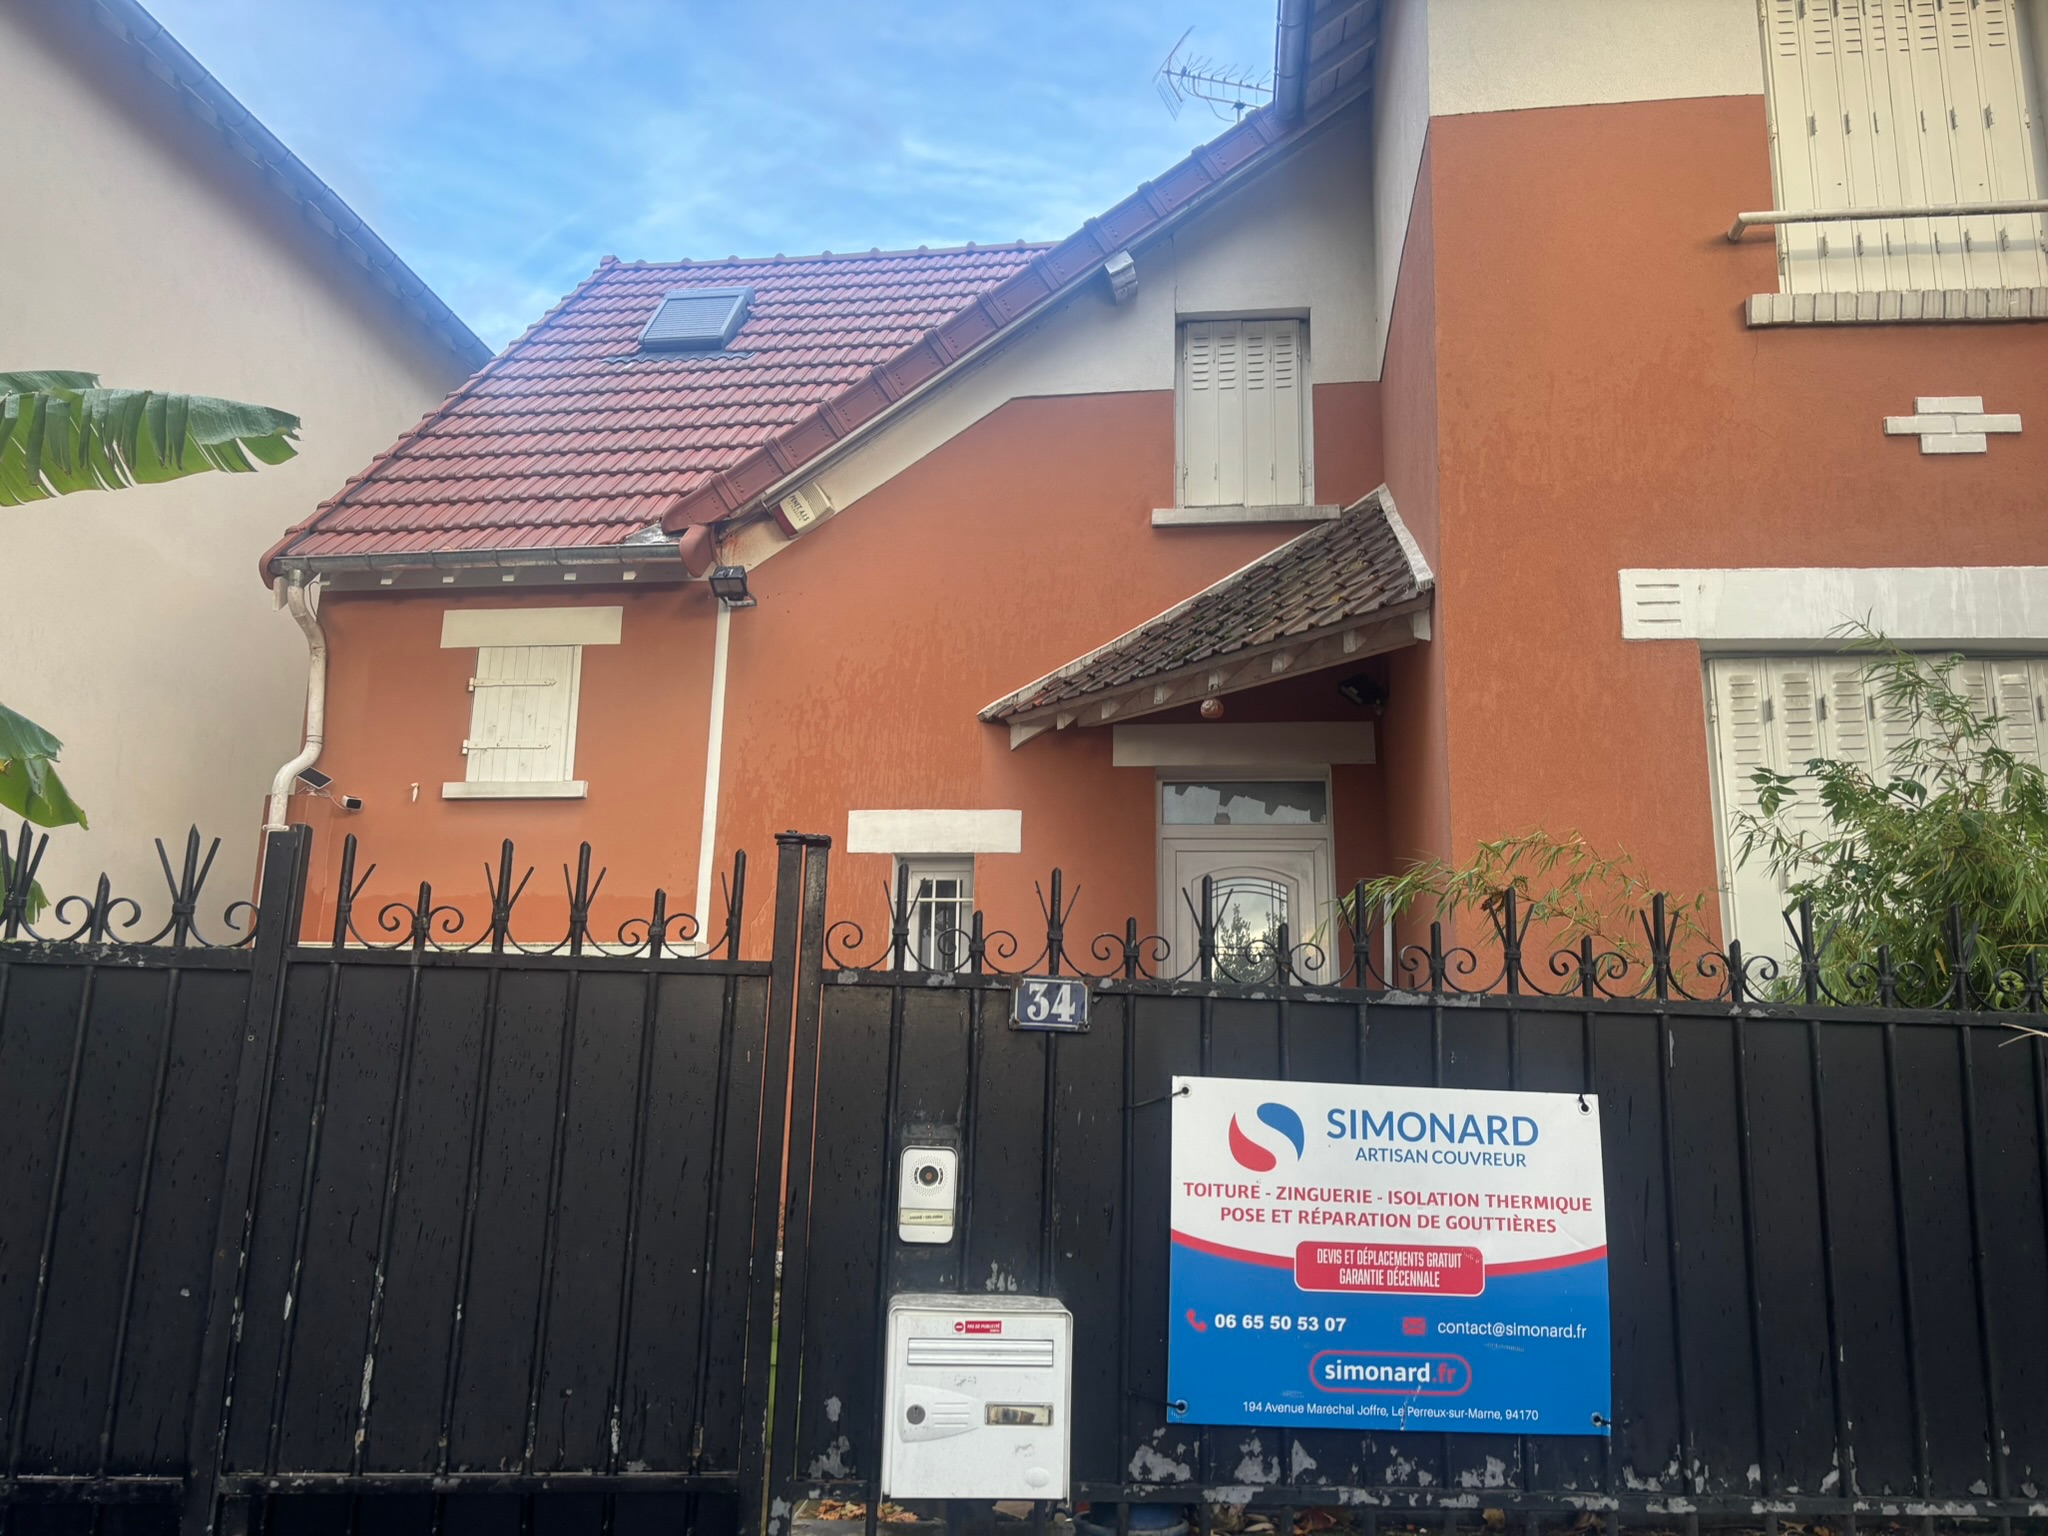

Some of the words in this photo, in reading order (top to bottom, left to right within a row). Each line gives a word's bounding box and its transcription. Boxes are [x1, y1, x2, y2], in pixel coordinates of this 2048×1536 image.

[1027, 983, 1076, 1022] 34
[1326, 1108, 1539, 1147] SIMONARD
[1355, 1147, 1428, 1164] ARTISAN
[1432, 1150, 1527, 1168] COUVREUR
[1183, 1182, 1261, 1200] TOITURE
[1276, 1186, 1373, 1204] ZINGUERIE
[1388, 1190, 1480, 1208] ISOLATION
[1485, 1194, 1593, 1214] THERMIQUE
[1220, 1207, 1266, 1223] POSE
[1271, 1209, 1292, 1224] ET
[1298, 1207, 1412, 1229] RÉPARATION
[1417, 1214, 1441, 1229] DE
[1445, 1214, 1557, 1234] GOUTTIÈRES
[1317, 1248, 1342, 1264] DEVIS
[1344, 1249, 1354, 1265] ET
[1357, 1246, 1425, 1268] DÉPLACEMENTS
[1426, 1251, 1462, 1269] GRATUIT
[1339, 1268, 1384, 1286] GARANTIE
[1387, 1266, 1440, 1288] DÉCENNALE
[1214, 1313, 1237, 1329] 06
[1242, 1315, 1264, 1330] 65
[1270, 1316, 1292, 1331] 50
[1297, 1317, 1319, 1332] 53
[1324, 1317, 1347, 1333] 07
[1437, 1321, 1588, 1339] contact@simonard.fr
[1324, 1359, 1457, 1384] simonard.fr
[1243, 1401, 1262, 1413] 194
[1264, 1403, 1305, 1414] Avenue
[1306, 1403, 1355, 1416] Maréchal
[1357, 1404, 1389, 1418] Joffre,
[1391, 1406, 1403, 1417] Le
[1407, 1406, 1503, 1421] Perreux-sur-Marne,
[1505, 1409, 1540, 1421] 94170
